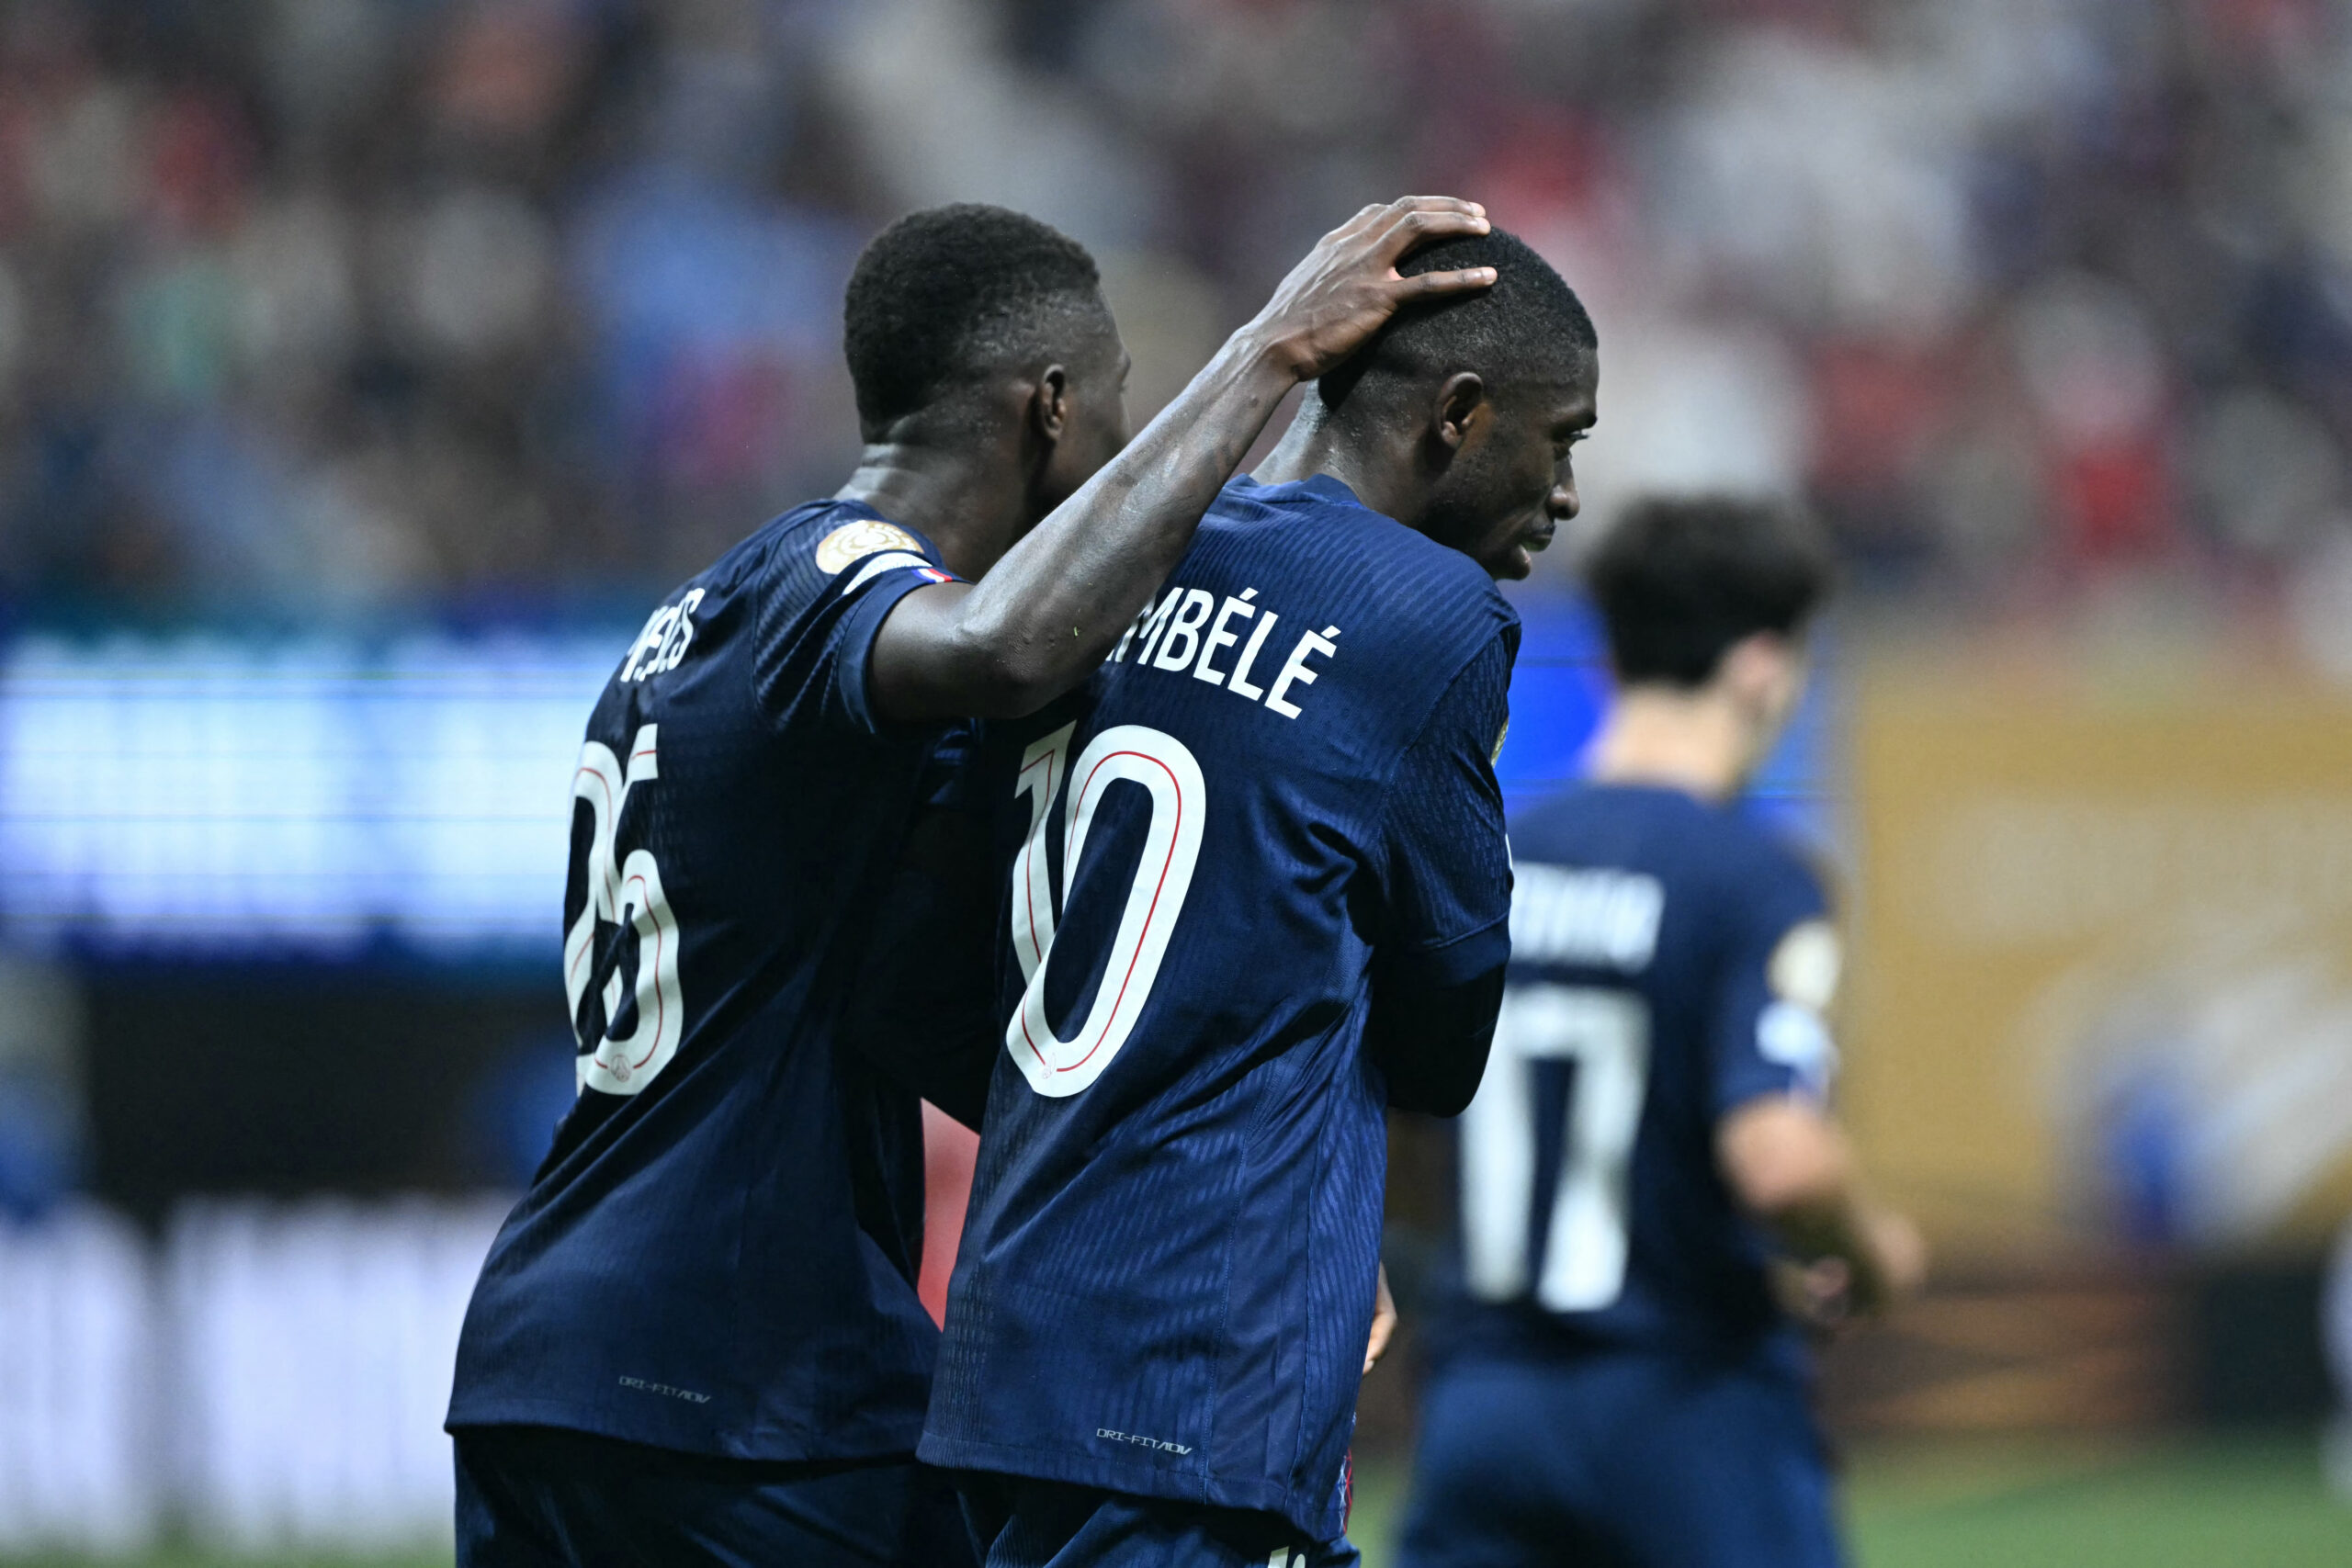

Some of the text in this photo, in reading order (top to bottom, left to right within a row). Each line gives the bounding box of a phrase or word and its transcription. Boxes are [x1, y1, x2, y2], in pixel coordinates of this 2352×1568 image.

[1105, 586, 1341, 719] MBÉLÉ
[1006, 719, 1206, 1099] 10
[1459, 981, 1654, 1314] 17
